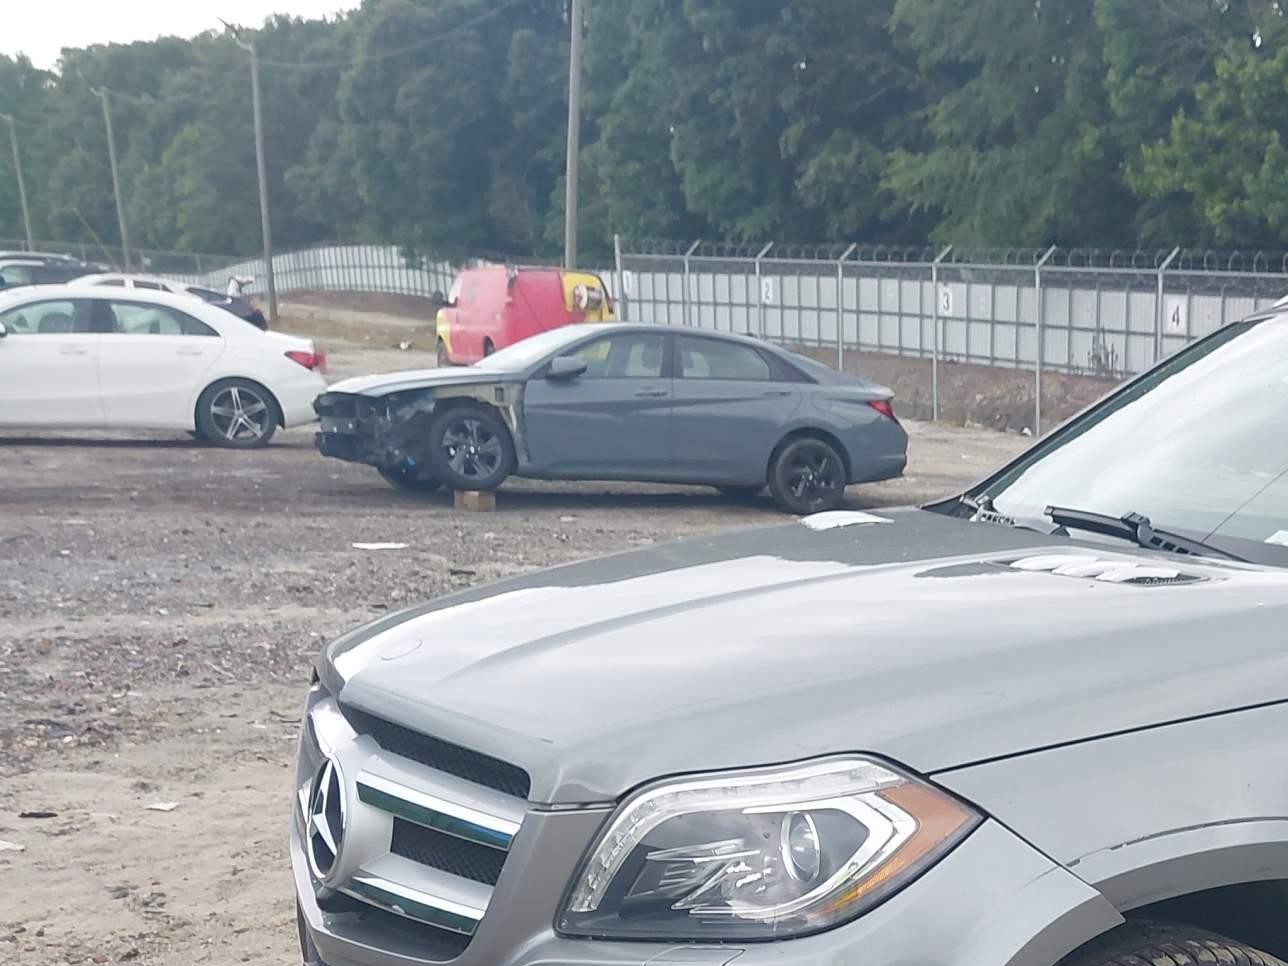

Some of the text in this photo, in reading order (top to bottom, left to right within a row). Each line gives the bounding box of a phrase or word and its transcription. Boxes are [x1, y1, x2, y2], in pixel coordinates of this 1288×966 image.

[765, 281, 771, 300] 2
[942, 293, 950, 311] 3
[1172, 306, 1180, 326] 4
